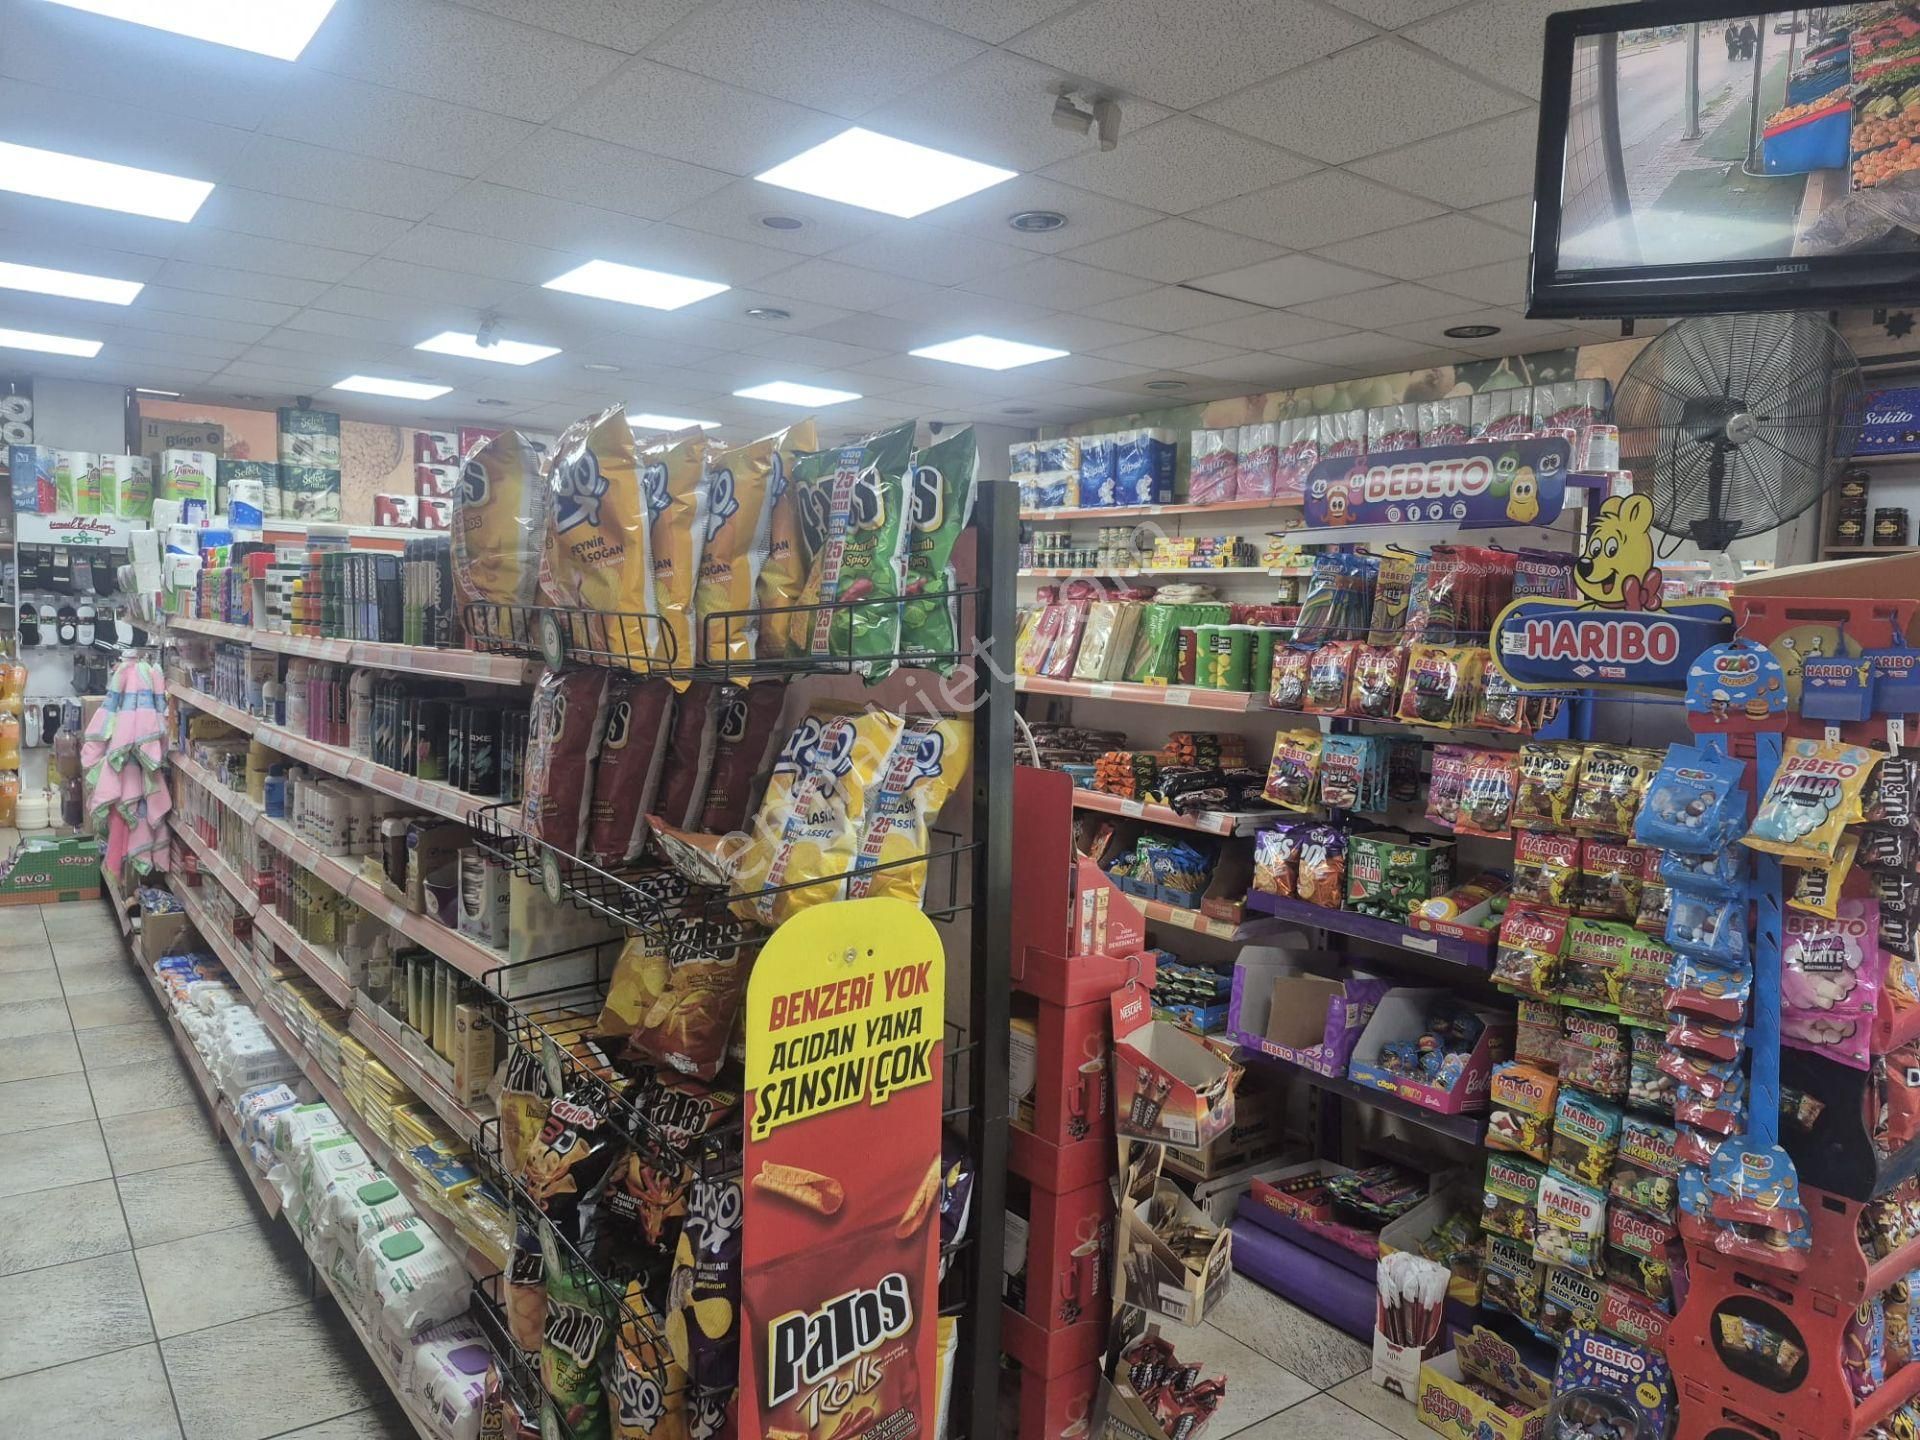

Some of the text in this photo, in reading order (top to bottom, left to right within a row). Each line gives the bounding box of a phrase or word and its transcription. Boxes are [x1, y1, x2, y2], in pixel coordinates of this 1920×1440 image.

[1776, 264, 1810, 274] VESTEL
[166, 434, 201, 448] Bingo
[836, 471, 856, 489] 25
[1364, 456, 1494, 502] BEBETO
[61, 535, 104, 545] SOFT
[825, 540, 844, 559] 25
[846, 554, 873, 567] Spicy
[1516, 561, 1559, 576] BEBETO
[1380, 571, 1411, 582] BEBETO
[1514, 585, 1552, 595] DOUBLE
[816, 609, 832, 627] 25
[1526, 619, 1679, 665] HARIBO
[1805, 664, 1853, 678] HARIBO
[469, 734, 491, 743] AXE
[1278, 747, 1313, 762] BEBETO
[1325, 753, 1360, 765] BEBETO
[1524, 755, 1571, 772] HARIBO
[1587, 760, 1640, 779] HARIBO
[1785, 757, 1858, 780] BEBETO
[1520, 836, 1570, 857] HARIBO
[1587, 845, 1644, 866] HARIBO
[1352, 853, 1382, 869] WATER
[1352, 866, 1382, 882] MELON
[850, 881, 870, 898] 25
[1505, 919, 1557, 943] HARIBO
[1786, 916, 1867, 937] BEBETO
[1572, 930, 1627, 950] HARIBO
[1629, 946, 1674, 965] HARIB
[768, 960, 933, 1033] BENZERİ YOK
[1565, 1016, 1618, 1040] HARIBO
[768, 1006, 923, 1076] ACIDAN YANA
[1261, 1041, 1294, 1062] BEBETO
[756, 1039, 931, 1134] ŞANSIN ÇOK
[1496, 1076, 1544, 1100] HARIBO
[1562, 1104, 1607, 1134] HARIBO
[1625, 1128, 1676, 1158] HARIBO
[1489, 1164, 1537, 1190] HARIBO
[1542, 1190, 1592, 1218] HARIBO
[1613, 1213, 1666, 1245] HARIBO
[1491, 1241, 1537, 1271] HARIBO
[1551, 1270, 1600, 1304] HARIBO
[1608, 1299, 1663, 1336] HARIBO
[1584, 1339, 1646, 1374] BEBETO
[1595, 1361, 1629, 1384] Bears
[795, 1355, 885, 1430] Rolls
[1640, 1389, 1657, 1402] NEW
[876, 1407, 907, 1432] Kırmızı
[882, 1412, 915, 1439] Aromalı
